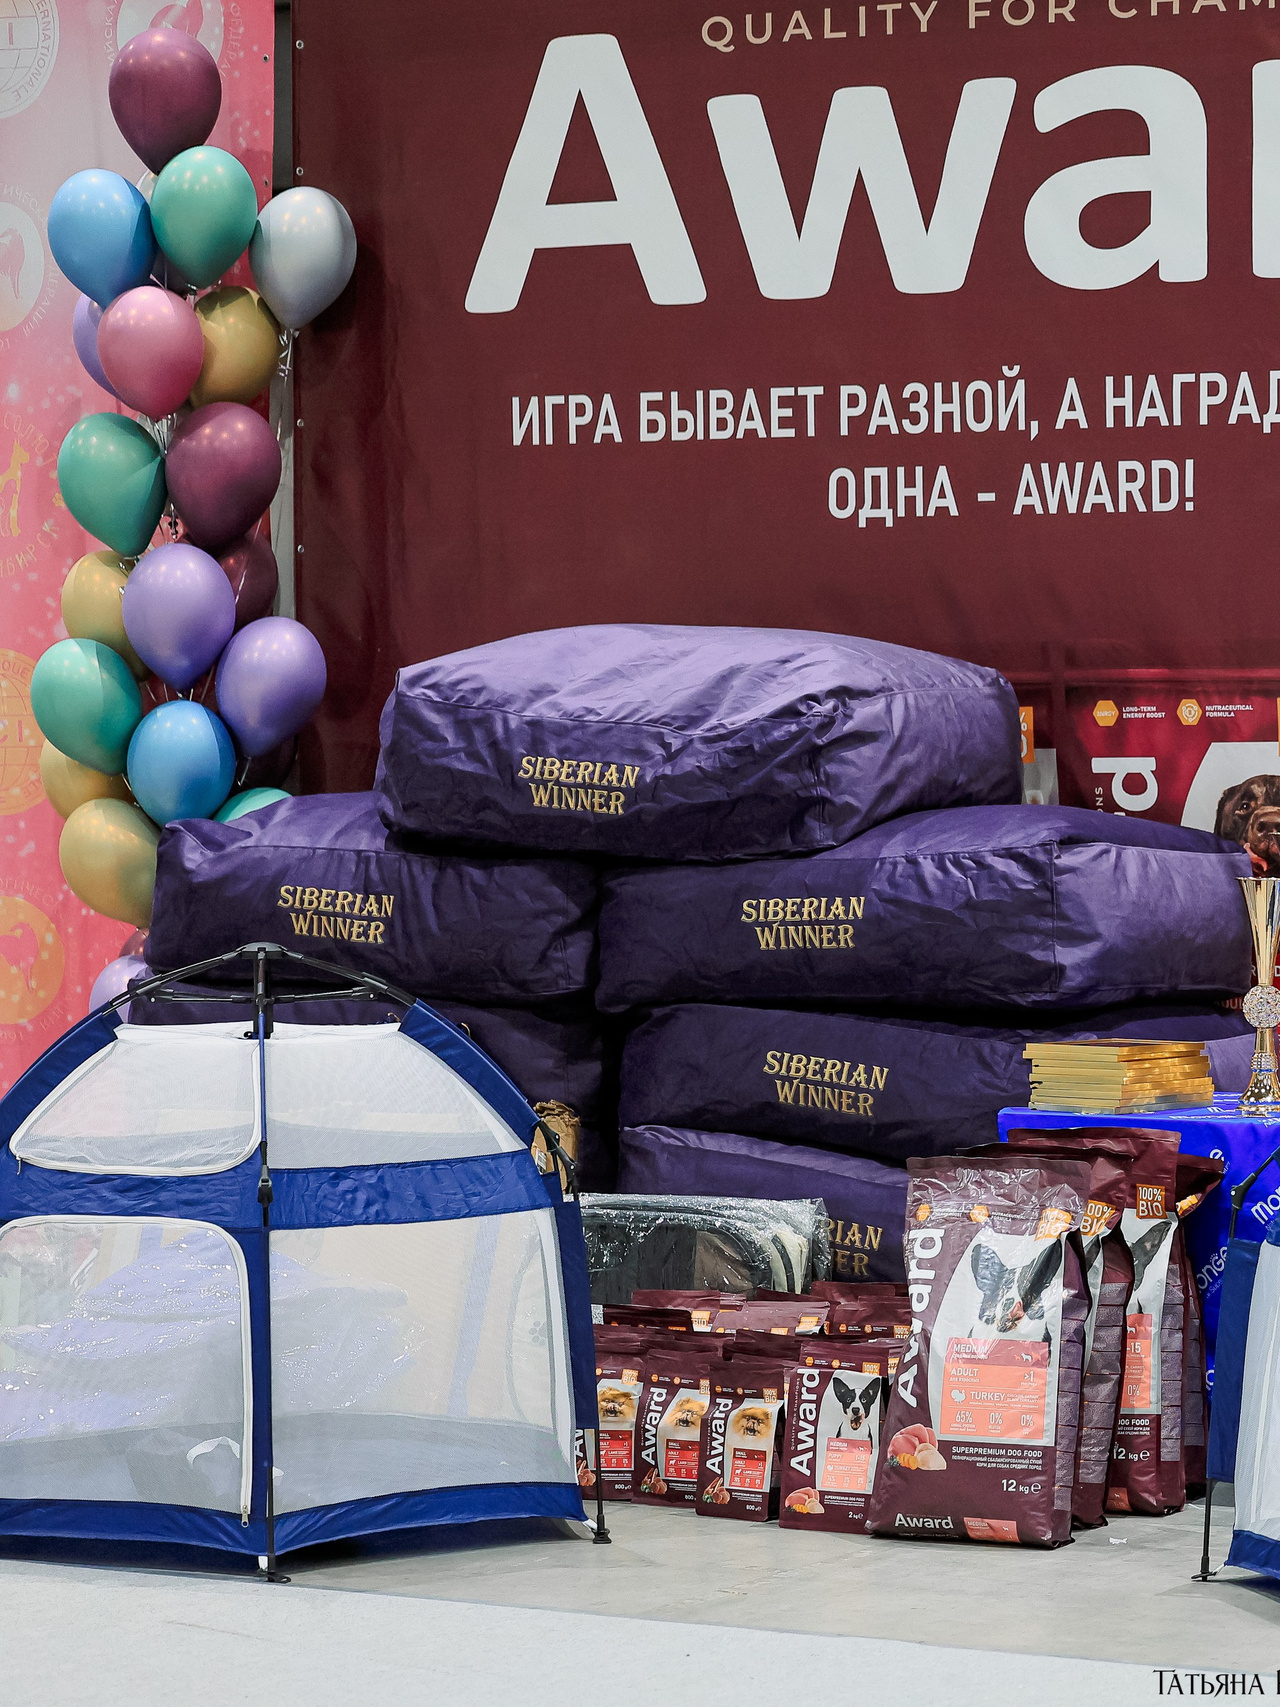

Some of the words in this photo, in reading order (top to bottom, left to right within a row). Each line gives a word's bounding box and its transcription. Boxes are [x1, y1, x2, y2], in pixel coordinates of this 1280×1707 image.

[701, 0, 937, 53] QUALITY
[512, 393, 622, 446] ИГРА
[639, 385, 824, 442] БЫВАЕТ
[840, 364, 1039, 441] РАЗНОЙ,
[1055, 377, 1089, 430] А
[828, 465, 959, 528] ОДНА
[1013, 458, 1195, 515] AWARD!
[1205, 704, 1253, 712] NUTRACEUTICAL
[518, 756, 640, 788] SIBERIAN
[528, 782, 626, 815] WINNER
[277, 885, 395, 919] SIBERIAN
[741, 896, 865, 922] SIBERIAN
[289, 909, 385, 944] WINNER
[754, 921, 855, 950] WINNER
[763, 1050, 889, 1092] SIBERIAN
[774, 1078, 875, 1117] WINNER
[1138, 1186, 1162, 1201] 100%
[1087, 1203, 1112, 1218] 00%
[1139, 1200, 1163, 1217] BIO
[953, 1343, 987, 1354] MEDIUM
[864, 1364, 879, 1372] 100%
[950, 1367, 978, 1376] ADULT
[1024, 1370, 1034, 1382] >1
[764, 1388, 777, 1396] 100%
[970, 1391, 1005, 1401] TURKEY
[1127, 1384, 1140, 1396] 0%
[765, 1395, 777, 1403] BIO
[790, 1368, 820, 1477] Award
[956, 1410, 973, 1423] 65%
[989, 1412, 1003, 1425] 0%
[1021, 1414, 1034, 1427] 0%
[641, 1387, 668, 1466] Award
[706, 1398, 733, 1475] Award
[952, 1446, 1006, 1456] SUPERPREMIUM
[1007, 1449, 1022, 1457] DOG
[1023, 1450, 1043, 1458] FOOD
[1128, 1452, 1138, 1462] kg
[1001, 1479, 1017, 1492] 12
[1019, 1484, 1029, 1494] kg
[894, 1513, 954, 1529] Award
